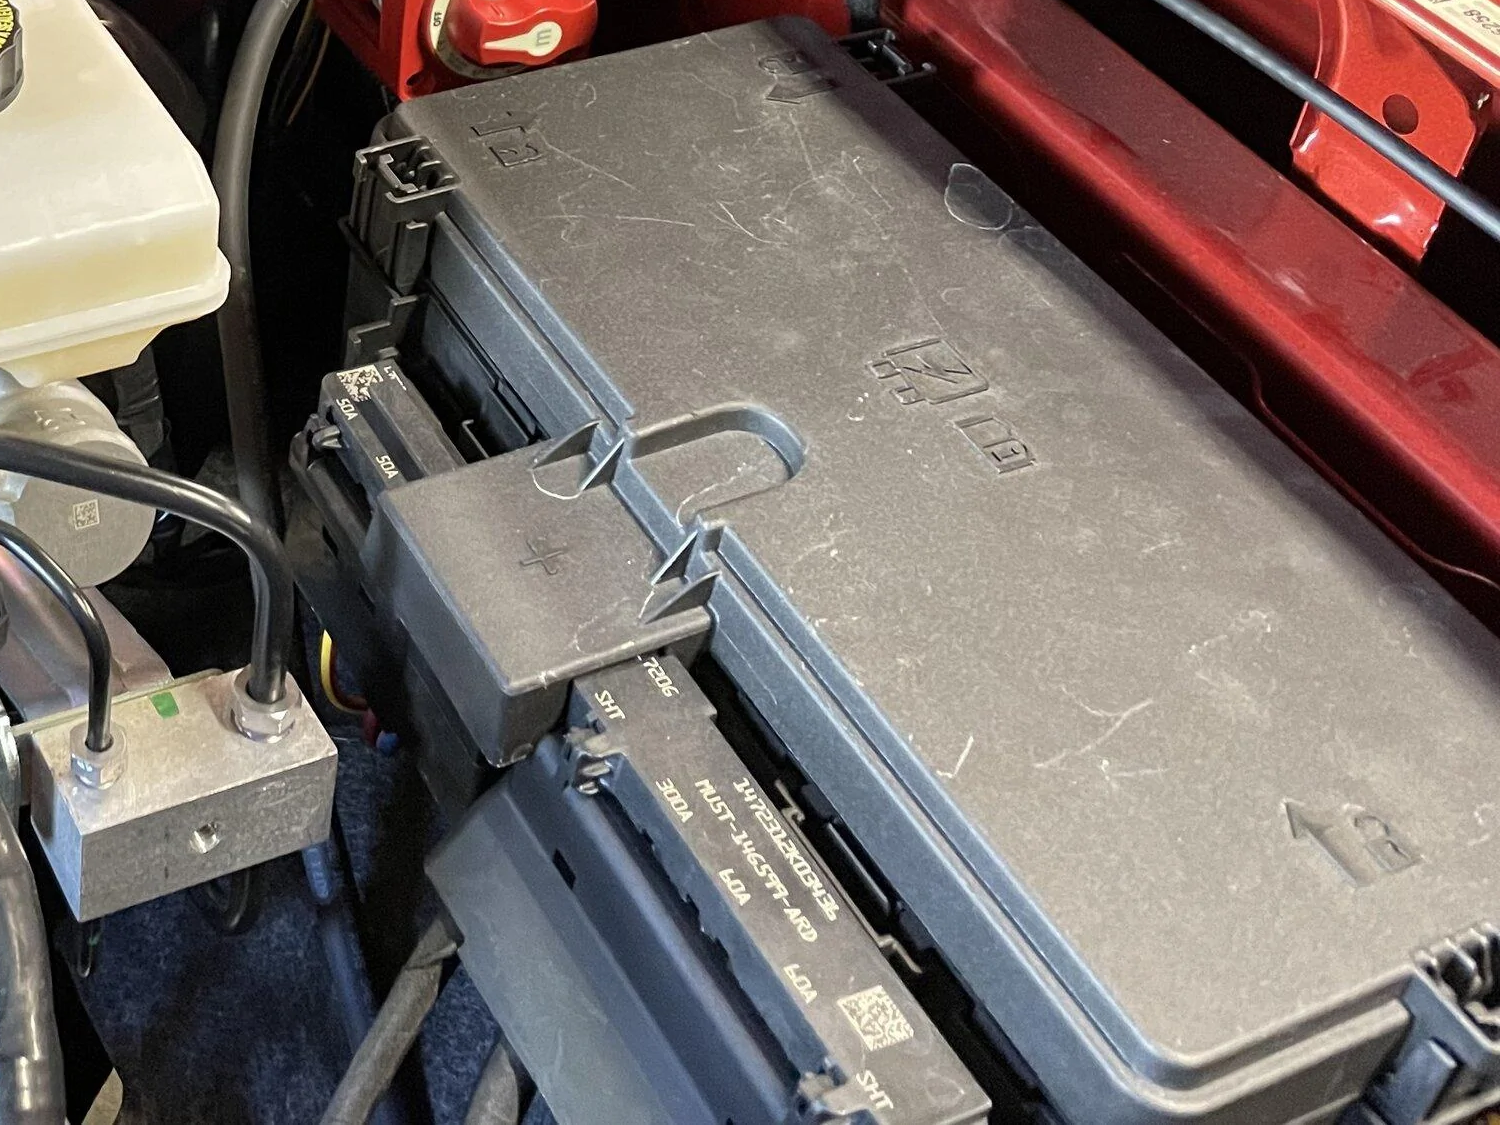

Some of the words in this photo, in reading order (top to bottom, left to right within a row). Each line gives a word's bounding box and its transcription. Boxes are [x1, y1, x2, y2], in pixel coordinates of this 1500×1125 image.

[434, 12, 442, 27] OFF
[335, 397, 358, 419] 50A
[375, 454, 399, 479] 50A
[654, 776, 694, 823] 300A
[718, 865, 752, 906] 60A
[785, 962, 818, 1004] 60A
